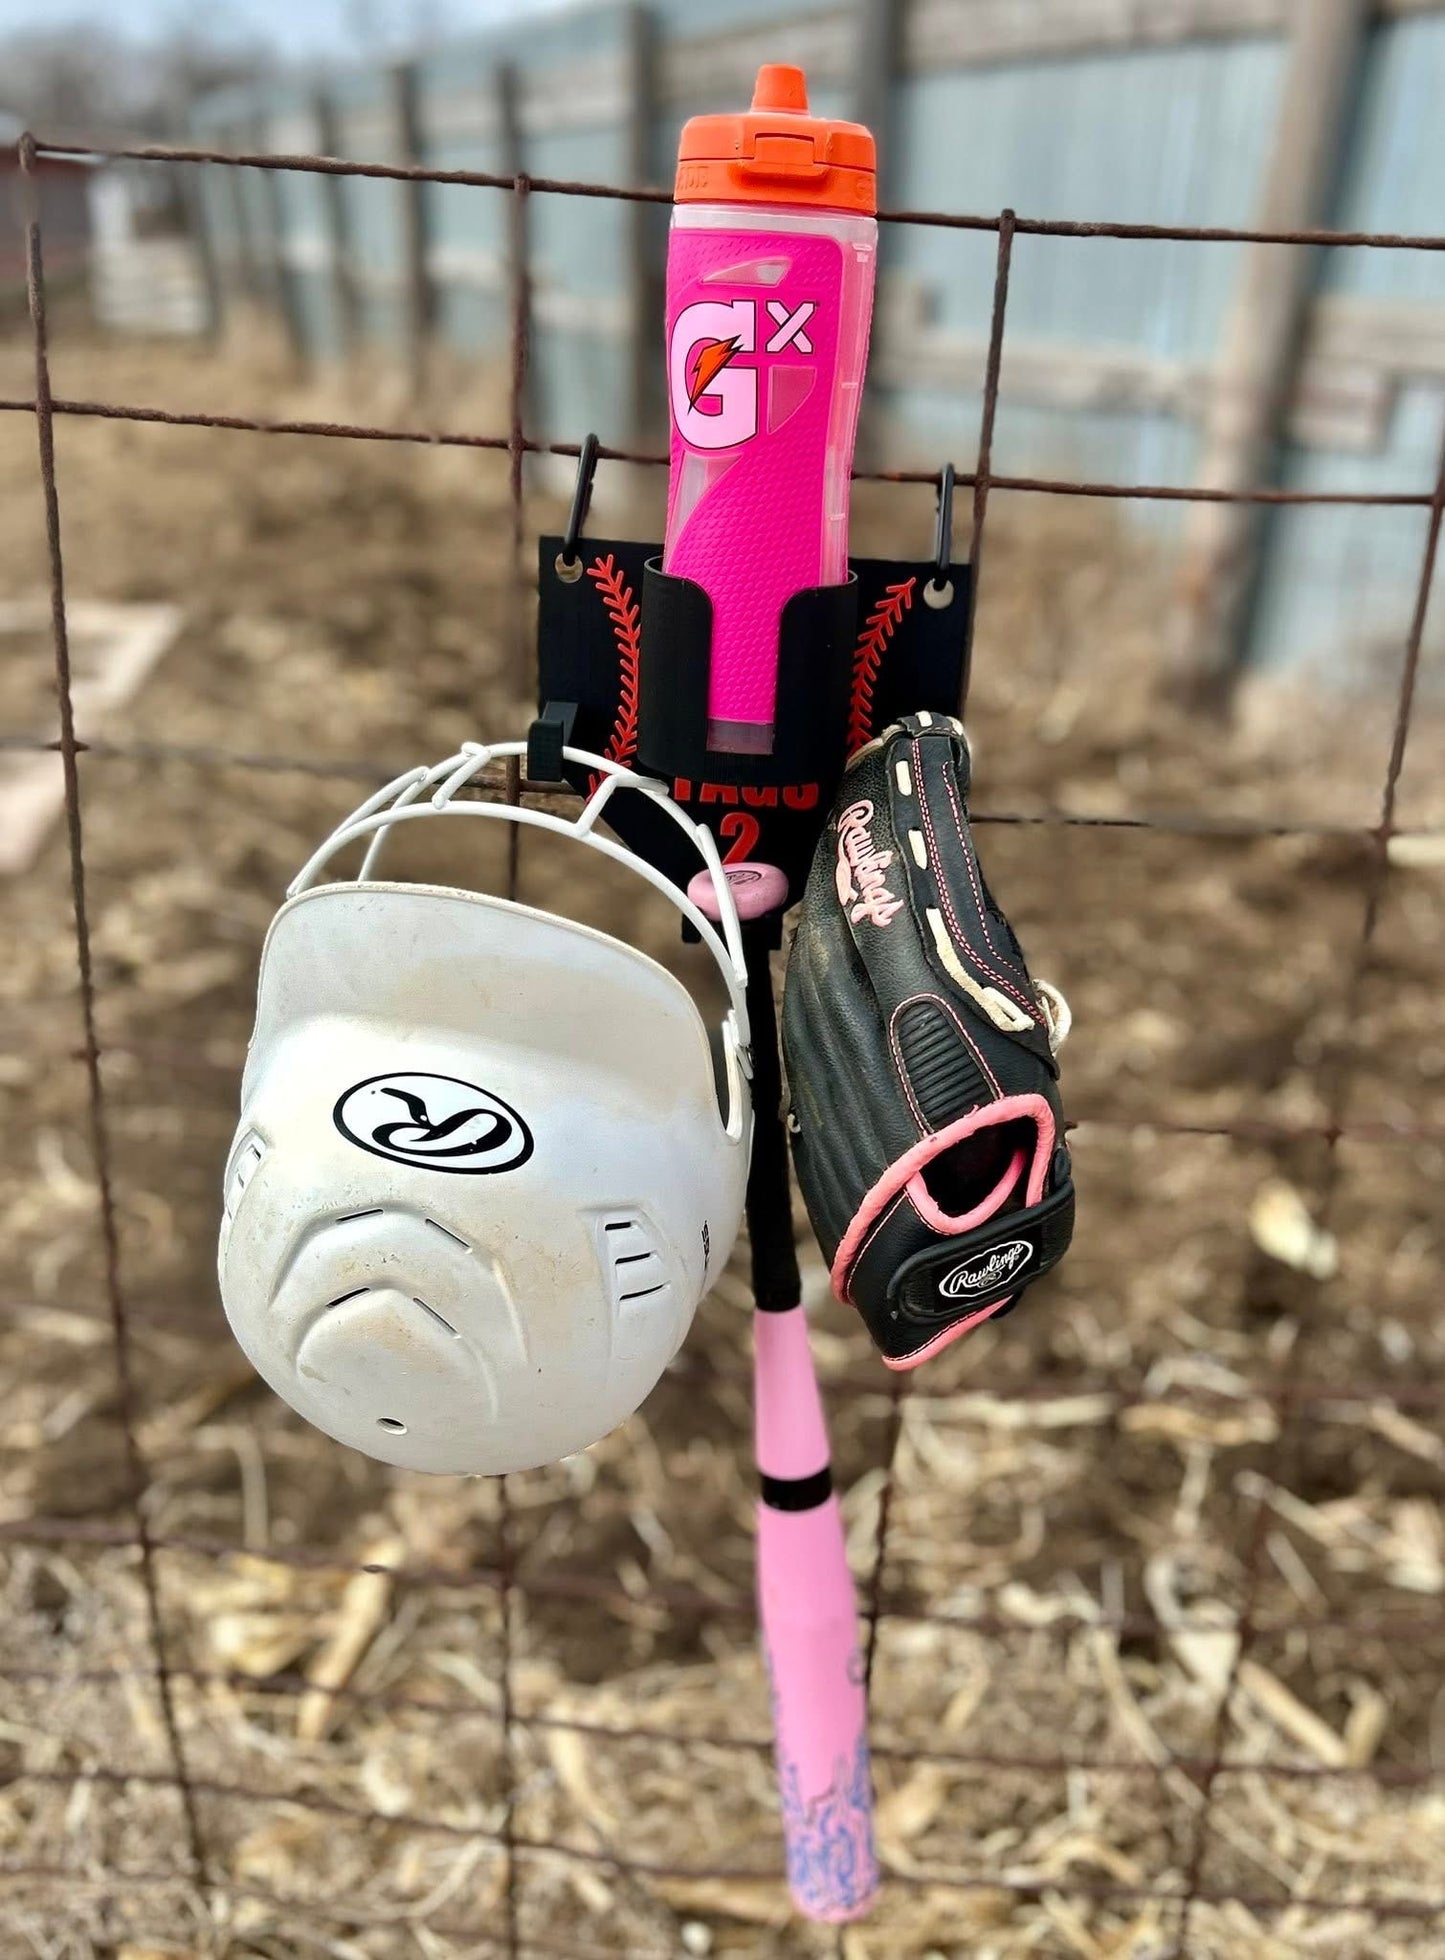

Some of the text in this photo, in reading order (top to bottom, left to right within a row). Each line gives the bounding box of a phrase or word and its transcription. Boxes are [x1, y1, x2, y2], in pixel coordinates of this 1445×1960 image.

[720, 811, 760, 864] 2
[836, 800, 905, 928] Rawlings
[949, 1243, 1024, 1294] Rawlings
